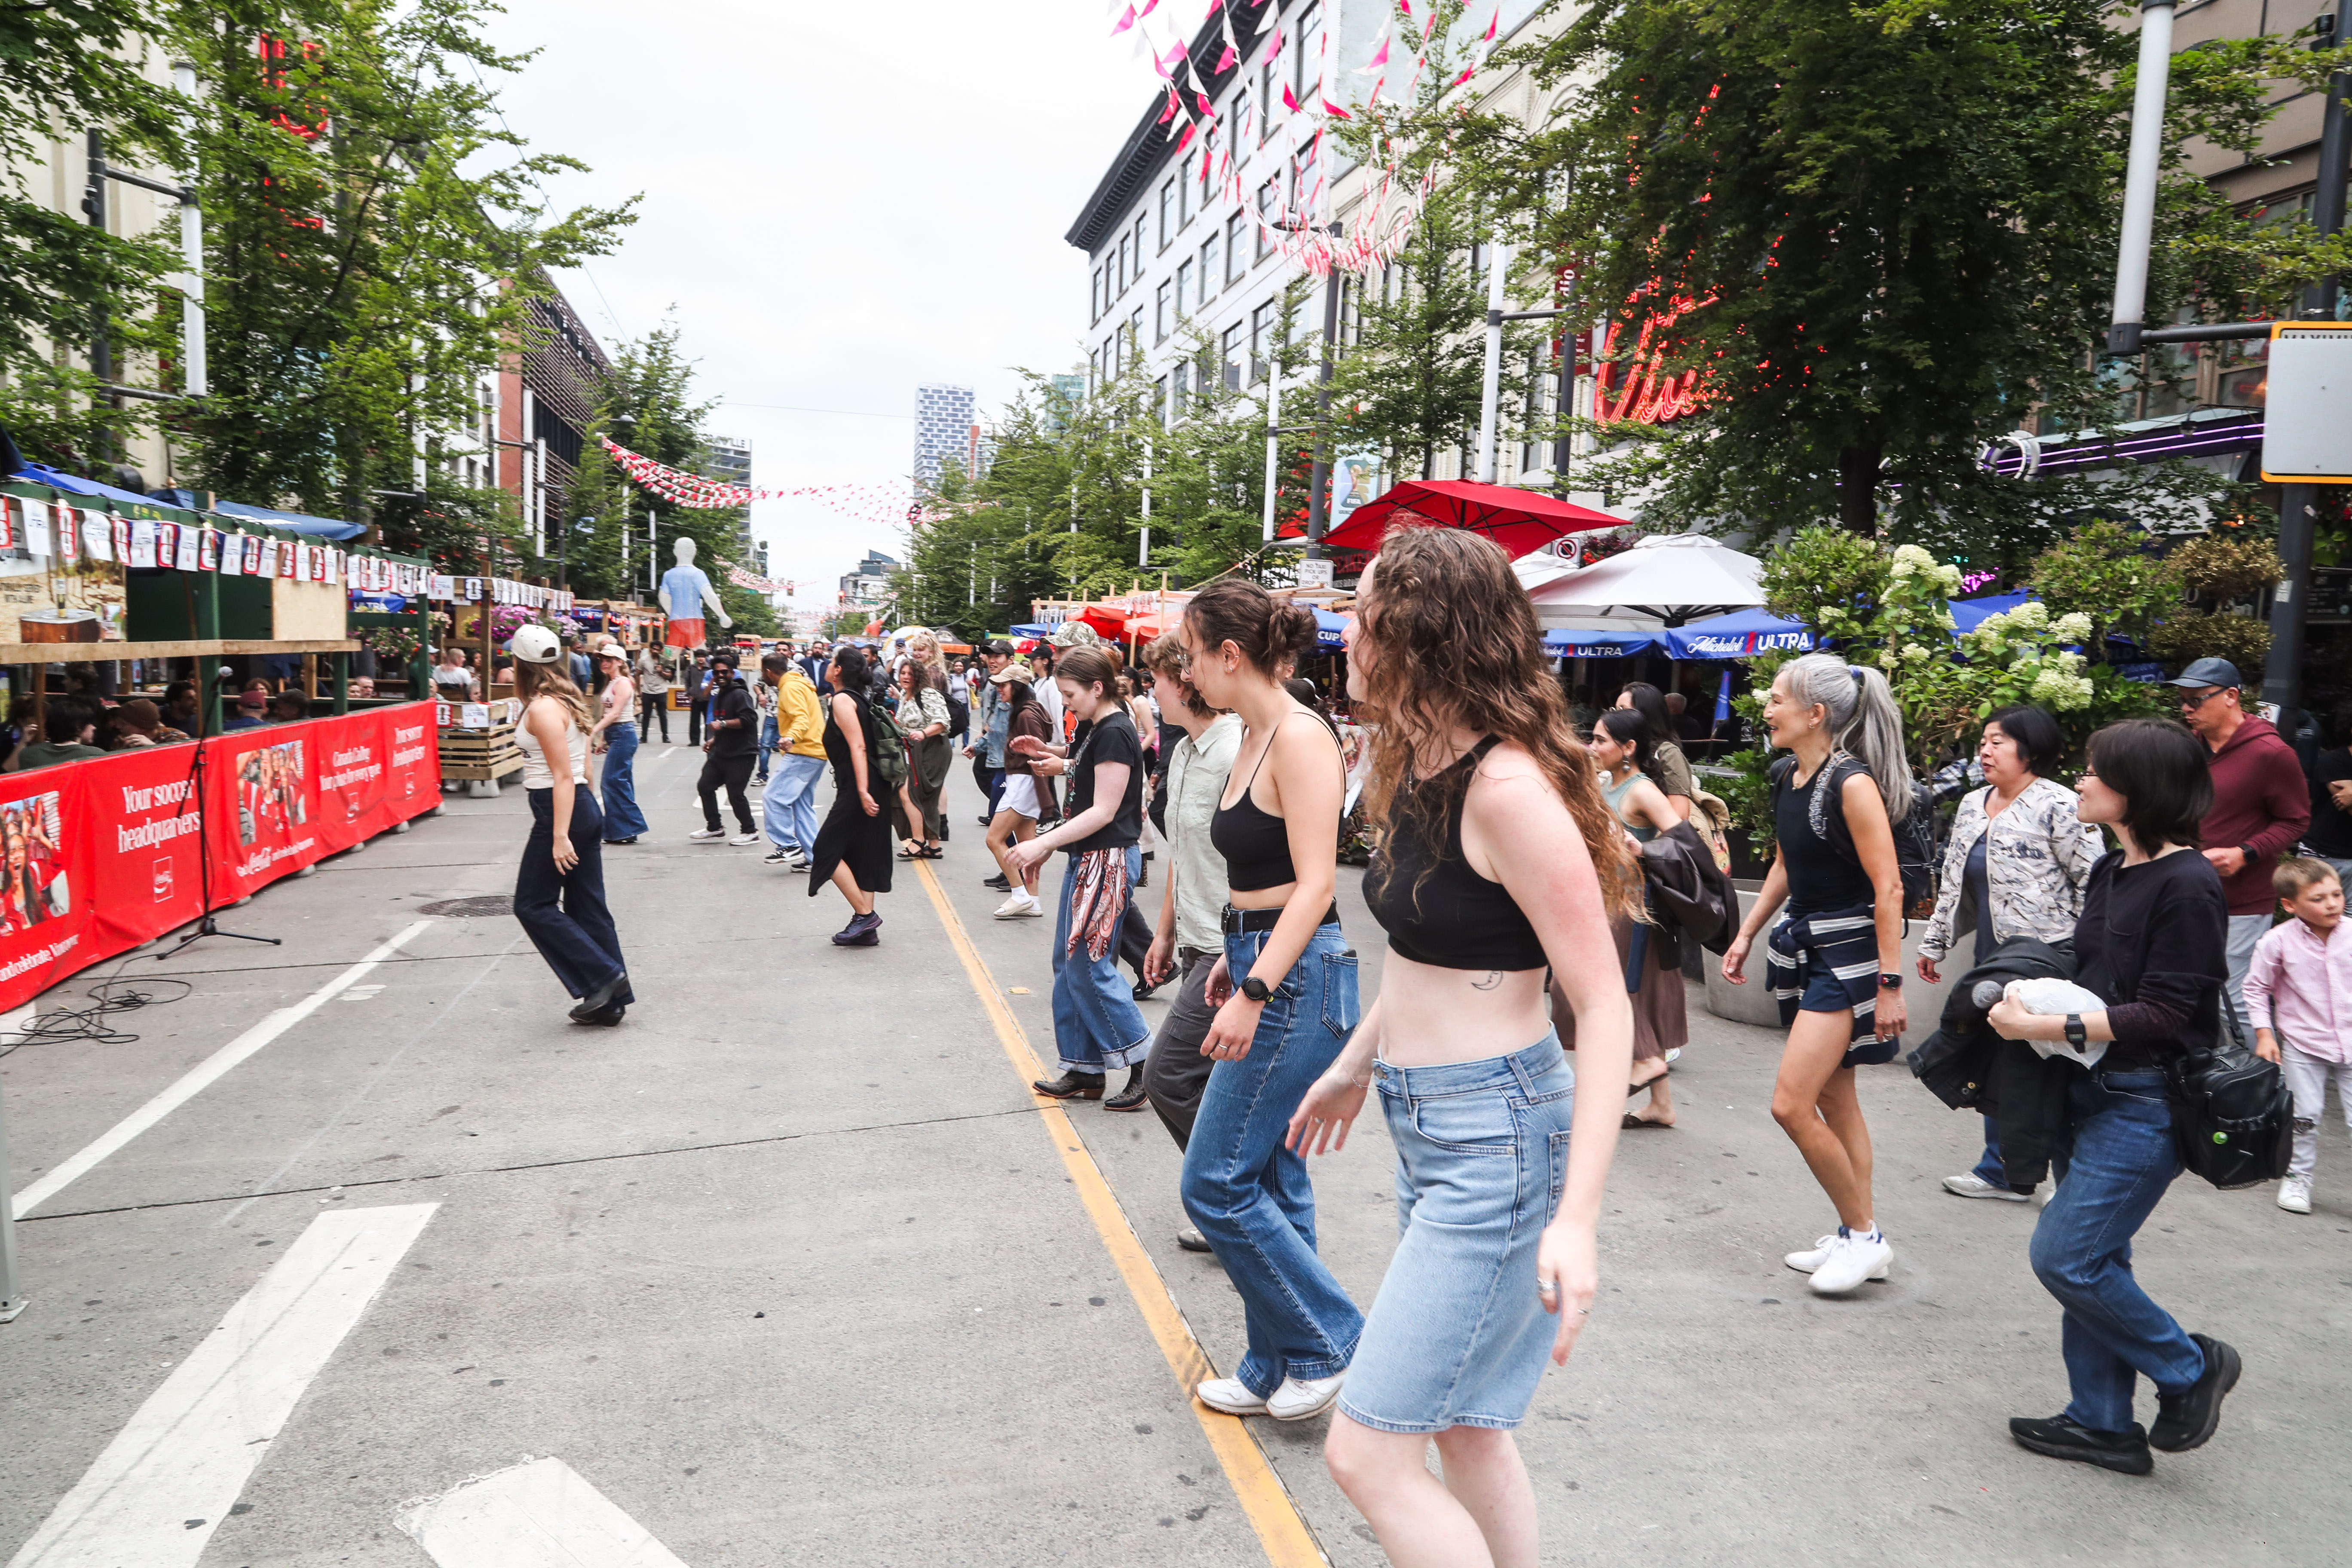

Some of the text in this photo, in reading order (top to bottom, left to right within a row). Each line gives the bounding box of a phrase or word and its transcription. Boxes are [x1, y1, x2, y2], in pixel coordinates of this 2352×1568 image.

[1318, 631, 1339, 641] CUP
[1687, 632, 1809, 653] Michelob ULTRA
[1577, 647, 1623, 656] ULTRA
[122, 779, 195, 814] Your soccer
[116, 811, 200, 854] headquarters
